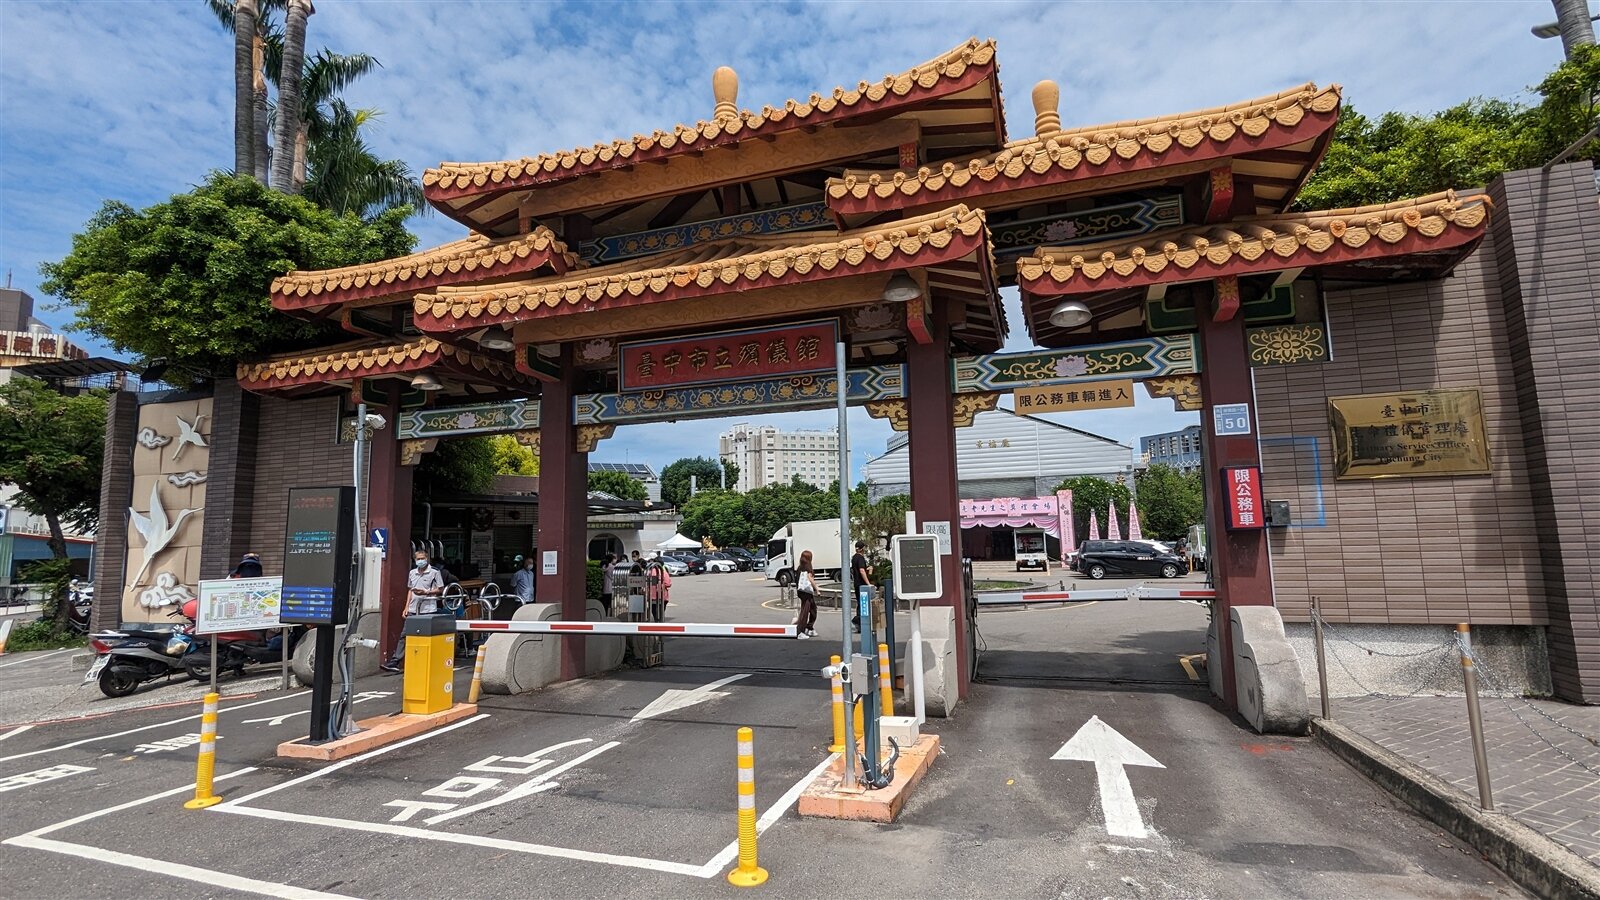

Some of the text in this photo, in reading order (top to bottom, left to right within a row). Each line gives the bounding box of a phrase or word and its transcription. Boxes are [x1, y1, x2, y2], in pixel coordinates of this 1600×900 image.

[636, 335, 822, 379] 臺中市立殯儀館
[1019, 388, 1129, 407] 限公務車輛進入
[1380, 402, 1430, 419] 臺中市
[1225, 417, 1246, 429] 50
[1397, 442, 1435, 450] Services
[1423, 453, 1442, 463] City
[1234, 469, 1255, 526] 限公務車
